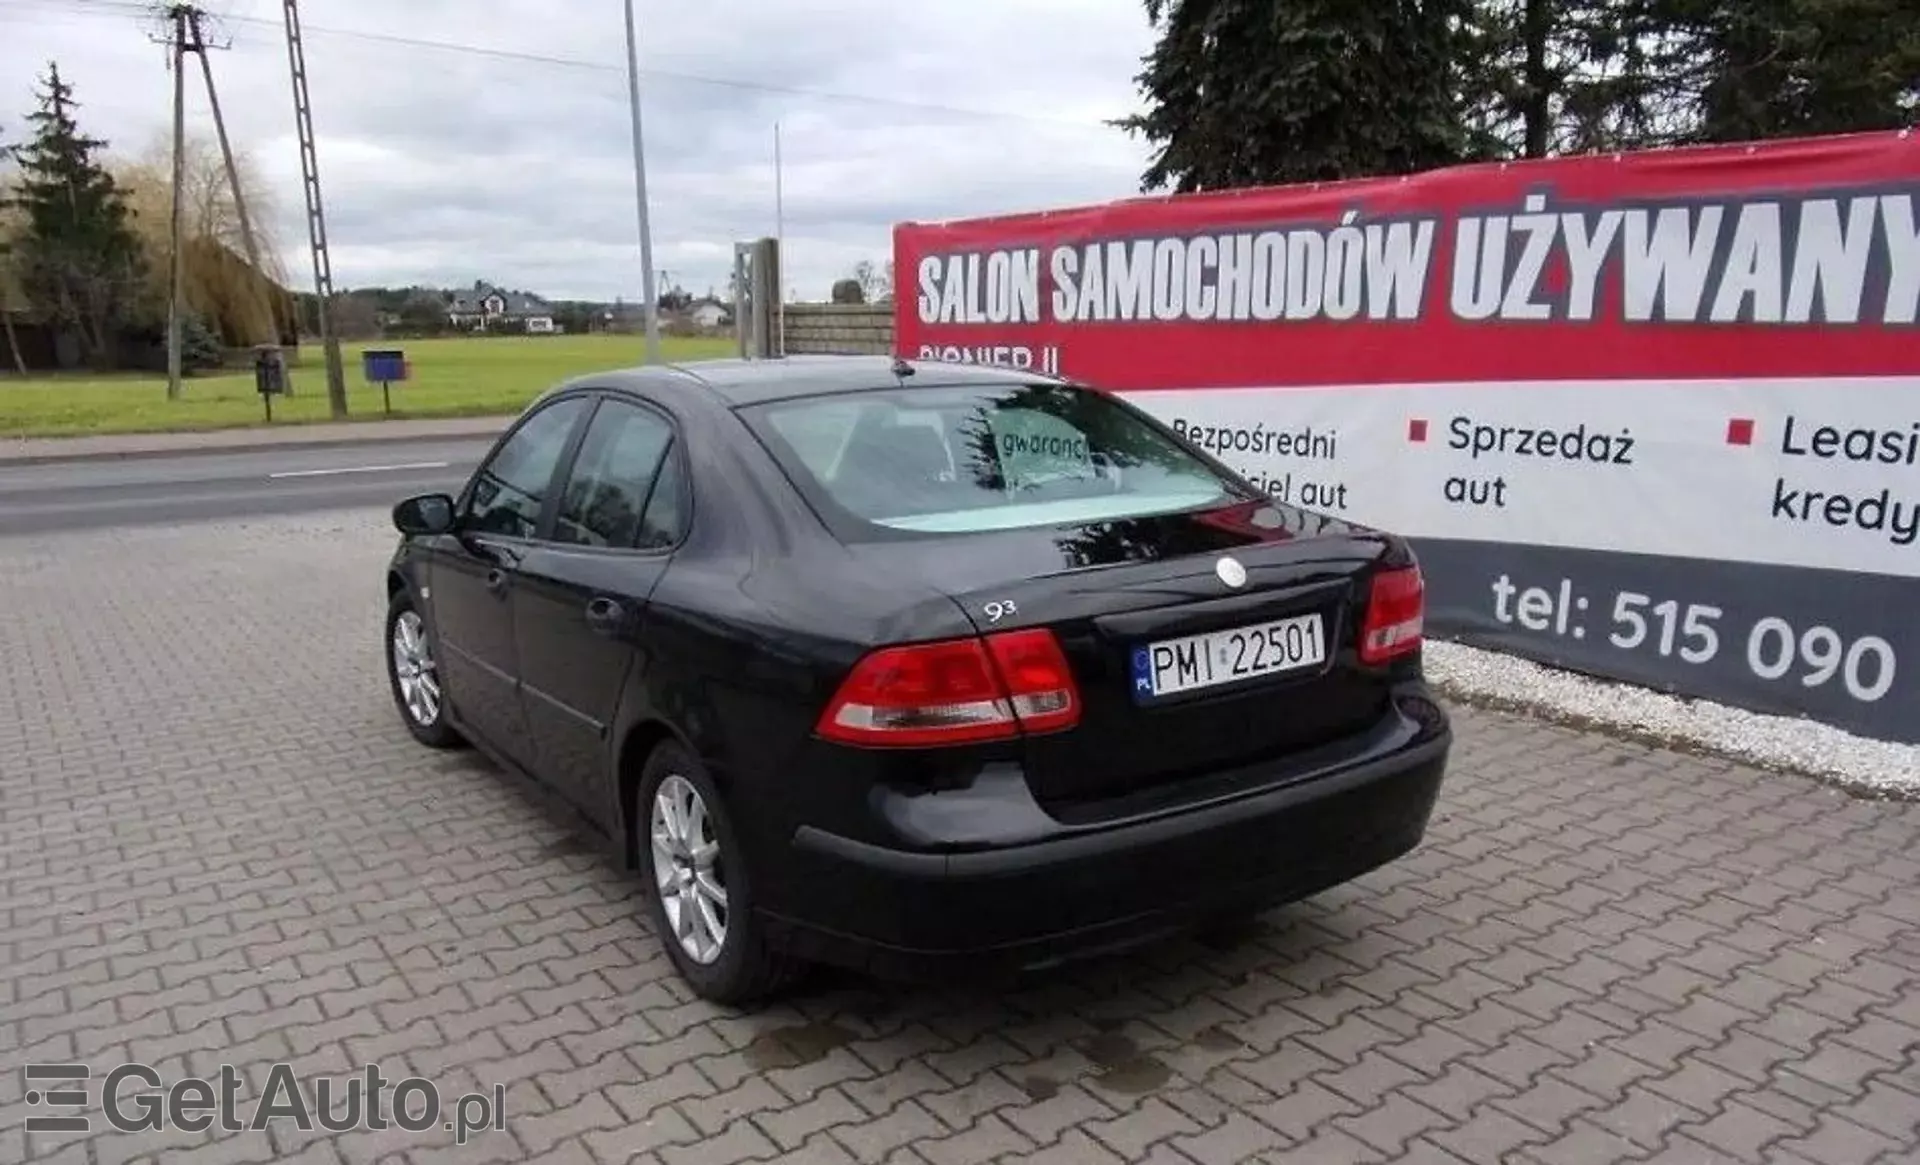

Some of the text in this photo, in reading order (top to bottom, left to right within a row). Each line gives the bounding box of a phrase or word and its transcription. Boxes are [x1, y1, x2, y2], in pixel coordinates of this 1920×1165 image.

[918, 194, 1920, 324] SALON SAMOCHODÓW UŻYWANY
[1173, 419, 1336, 459] Bezpośredni
[1448, 416, 1635, 465] Sprzedaż
[1782, 415, 1920, 465] Leasi
[1301, 483, 1347, 510] aut
[1444, 476, 1507, 507] aut
[1772, 477, 1920, 545] kredy
[1153, 618, 1318, 690] PMI 22501
[1491, 574, 1897, 702] tel: 515 090
